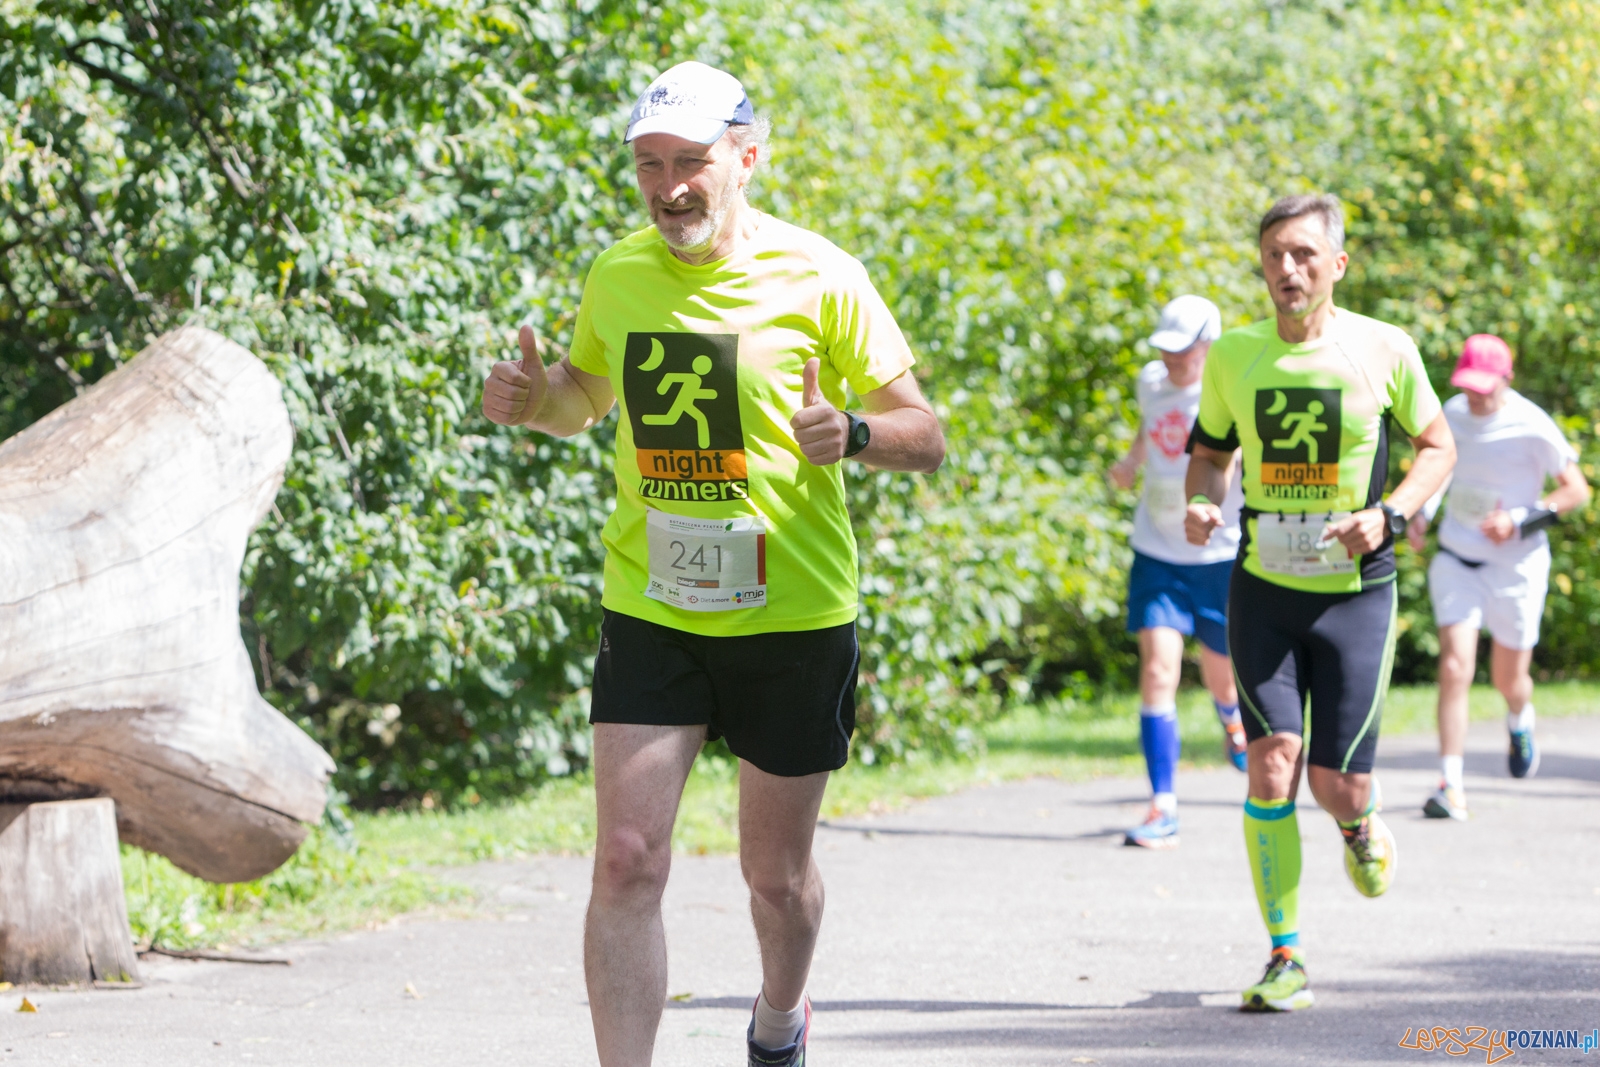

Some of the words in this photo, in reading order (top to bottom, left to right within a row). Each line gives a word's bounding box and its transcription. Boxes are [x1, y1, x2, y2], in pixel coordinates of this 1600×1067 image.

[653, 450, 725, 479] night
[1275, 463, 1325, 484] night
[639, 478, 748, 501] runners
[1263, 484, 1339, 499] runners
[670, 540, 722, 573] 241
[744, 589, 765, 599] mjp
